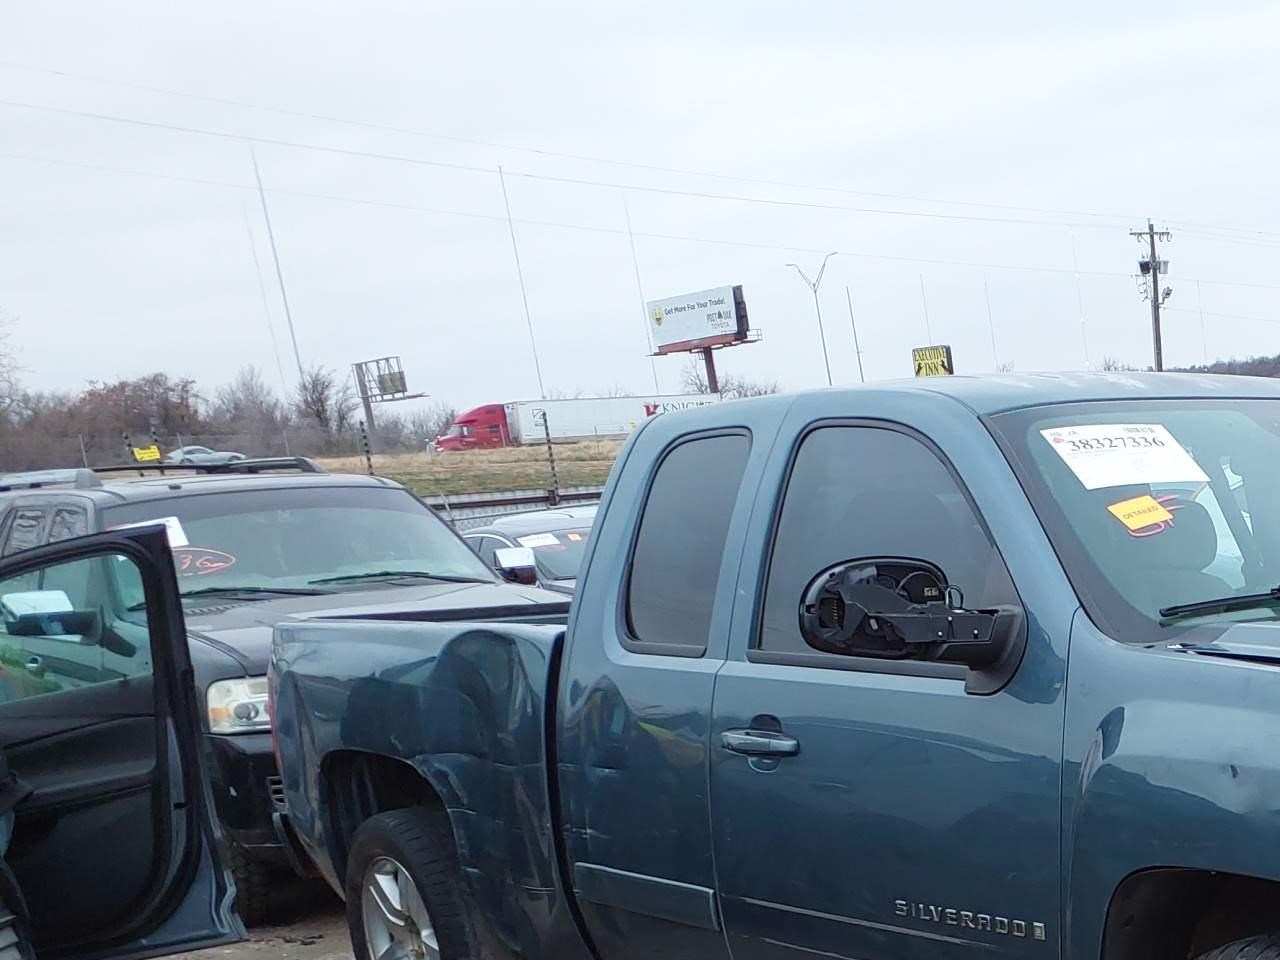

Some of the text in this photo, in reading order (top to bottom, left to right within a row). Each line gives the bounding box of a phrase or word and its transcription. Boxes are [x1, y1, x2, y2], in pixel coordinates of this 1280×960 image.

[664, 307, 674, 316] Get
[674, 304, 687, 314] More
[687, 303, 696, 312] For
[696, 301, 708, 310] Your
[711, 322, 730, 330] TOYOTA
[924, 361, 939, 377] INN
[1066, 436, 1166, 451] 38327336
[1123, 505, 1158, 520] DETAILED
[895, 900, 1026, 937] SILVERADO
